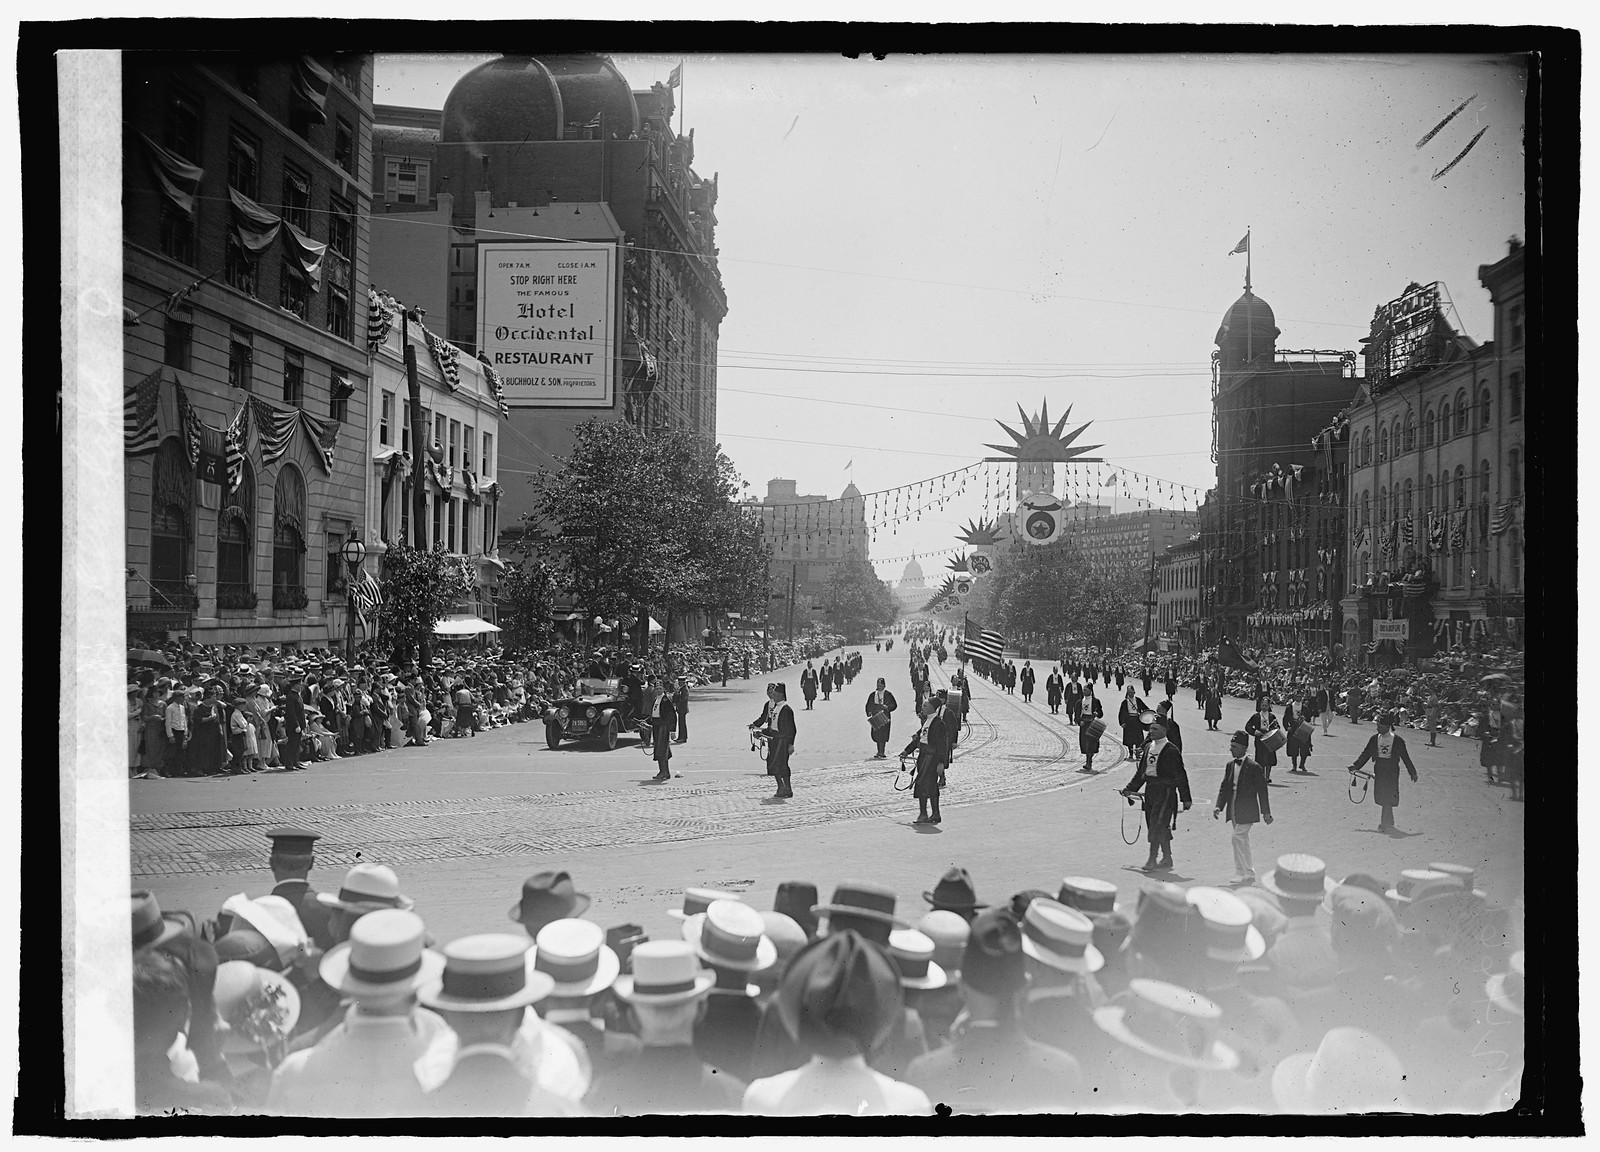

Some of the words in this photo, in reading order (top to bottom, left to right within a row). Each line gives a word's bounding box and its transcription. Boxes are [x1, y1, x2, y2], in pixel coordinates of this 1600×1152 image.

[510, 275, 530, 285] STOP
[532, 275, 555, 285] RIGHT
[557, 275, 578, 285] HERE
[516, 303, 575, 319] Hotel
[495, 325, 595, 341] Occidental
[495, 352, 594, 365] RESTAURANT
[506, 377, 539, 386] BUCHHOLZ
[541, 377, 546, 386] &
